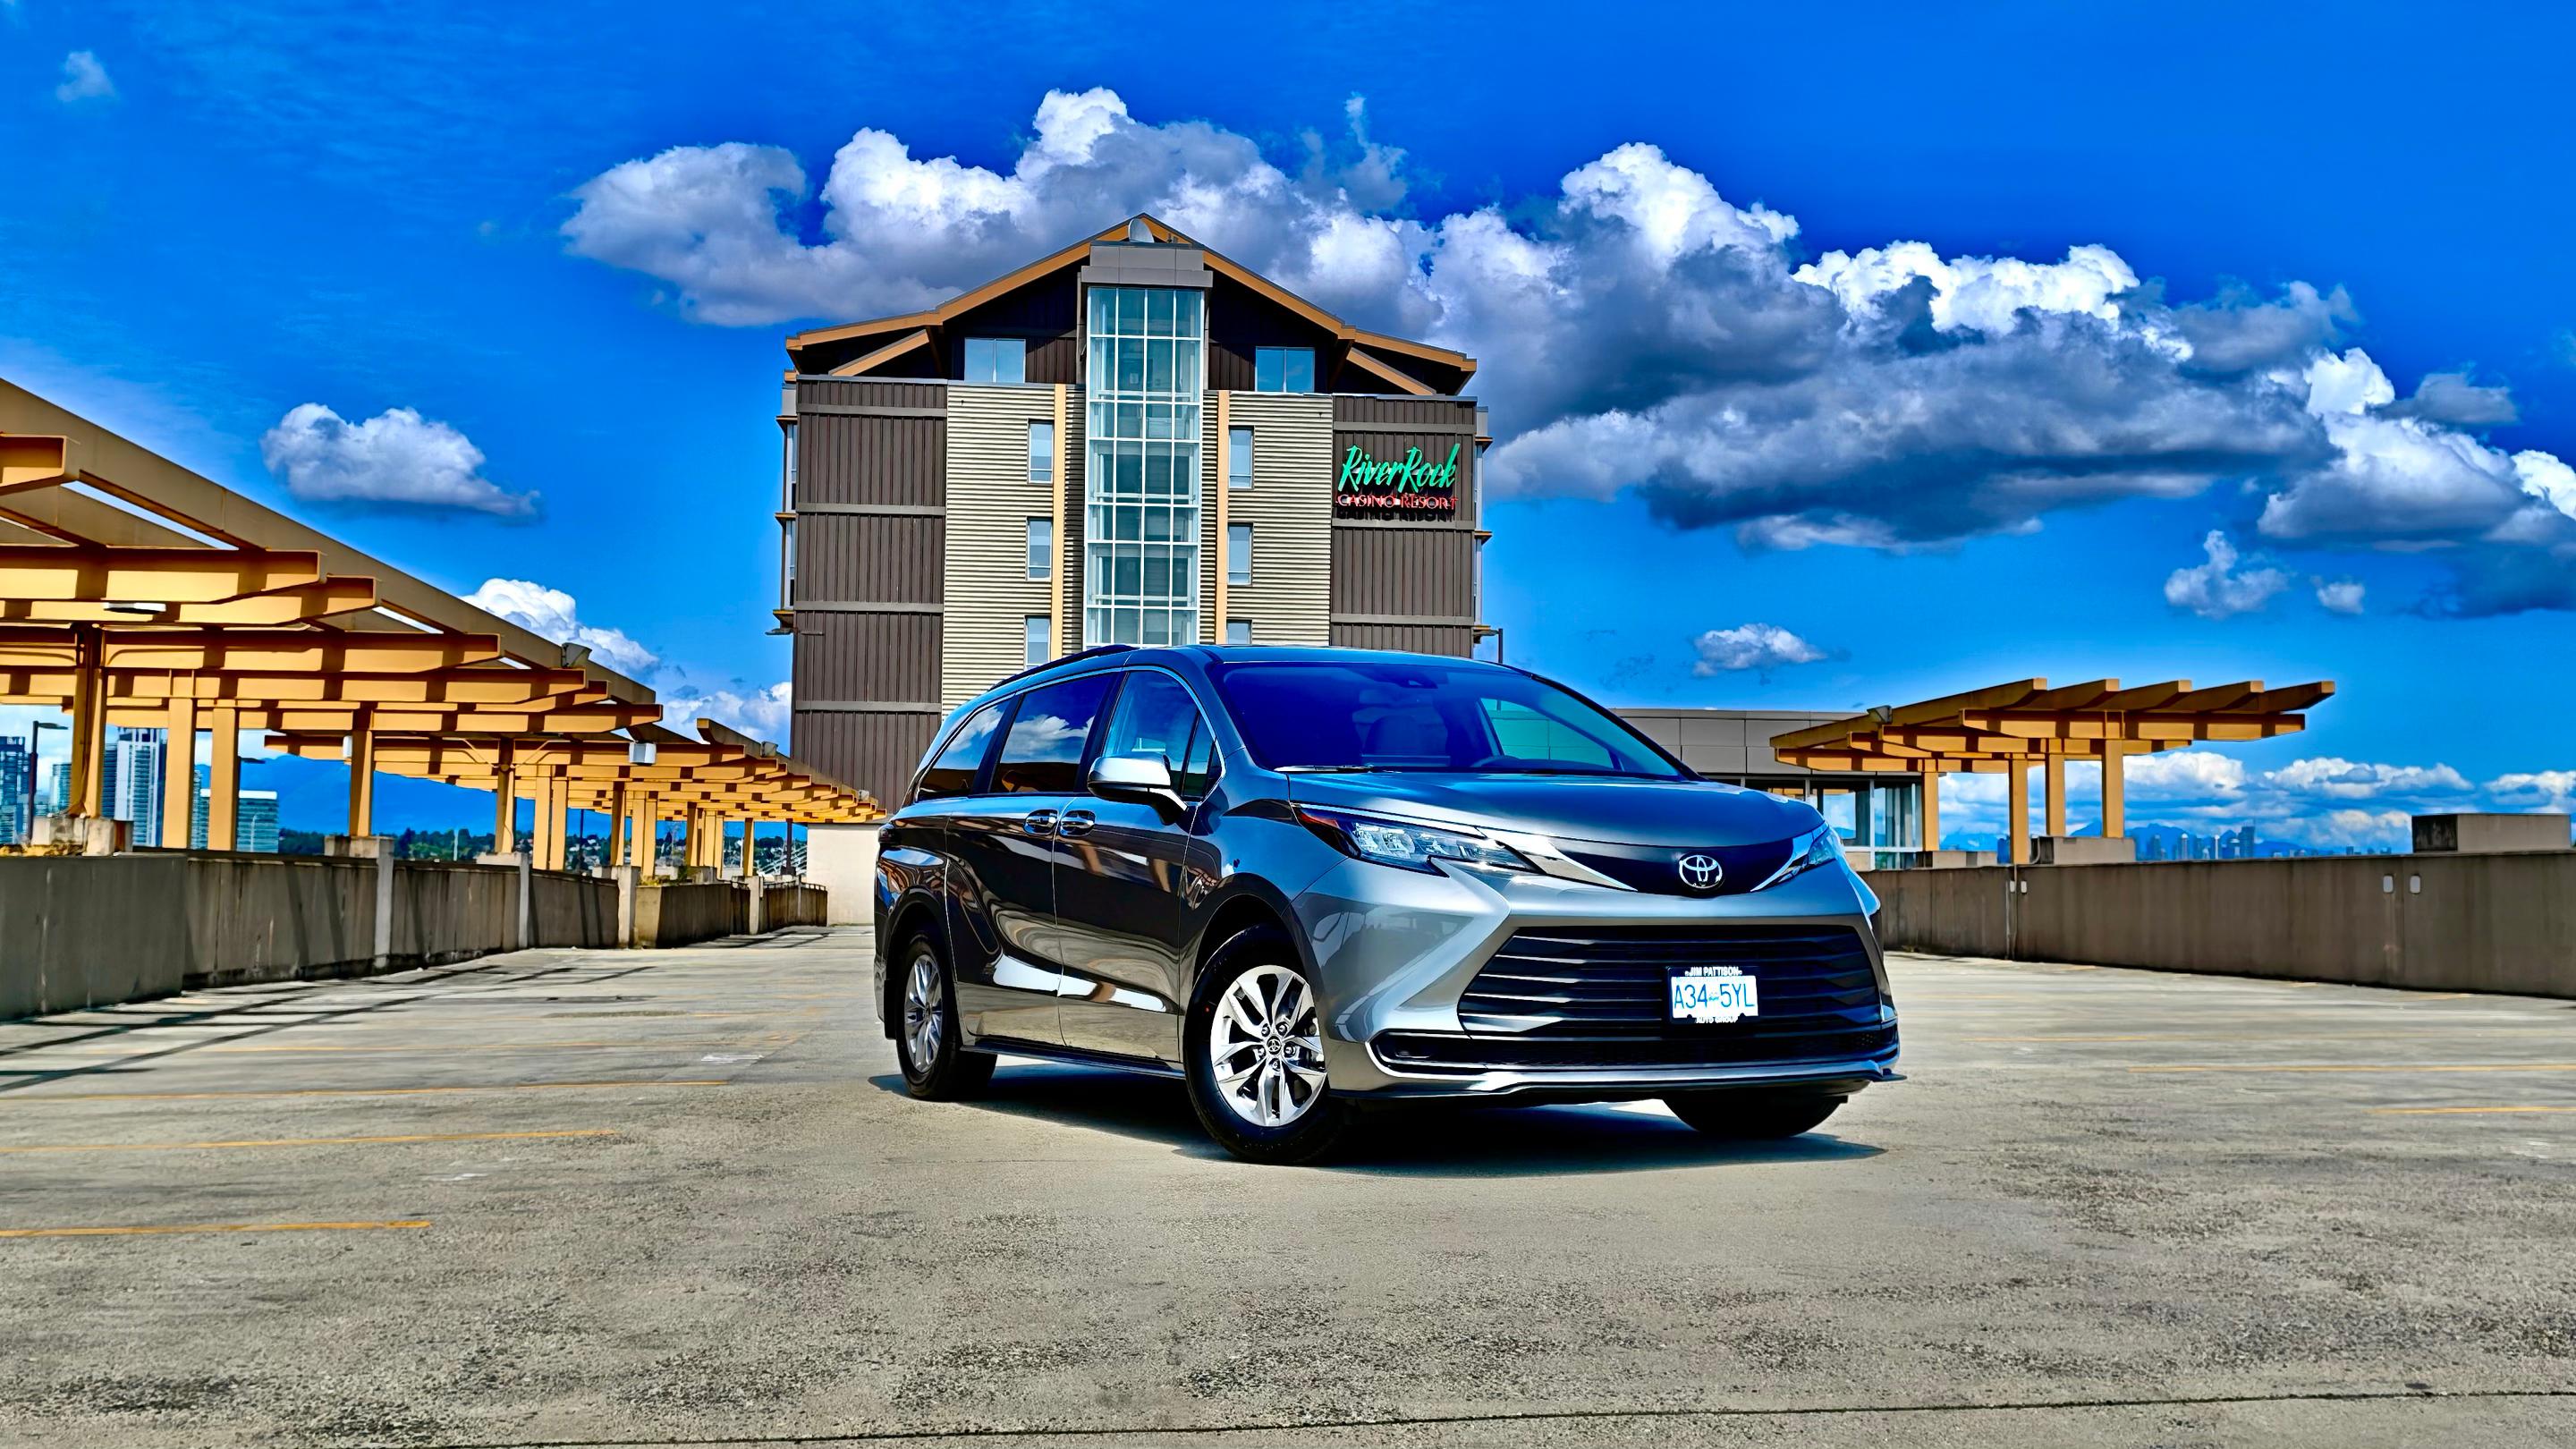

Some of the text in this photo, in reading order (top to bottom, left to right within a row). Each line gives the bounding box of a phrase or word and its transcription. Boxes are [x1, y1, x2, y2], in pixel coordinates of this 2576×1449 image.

[1337, 494, 1459, 510] CASINO RESORT
[1690, 966, 1740, 977] JIM PATTISON
